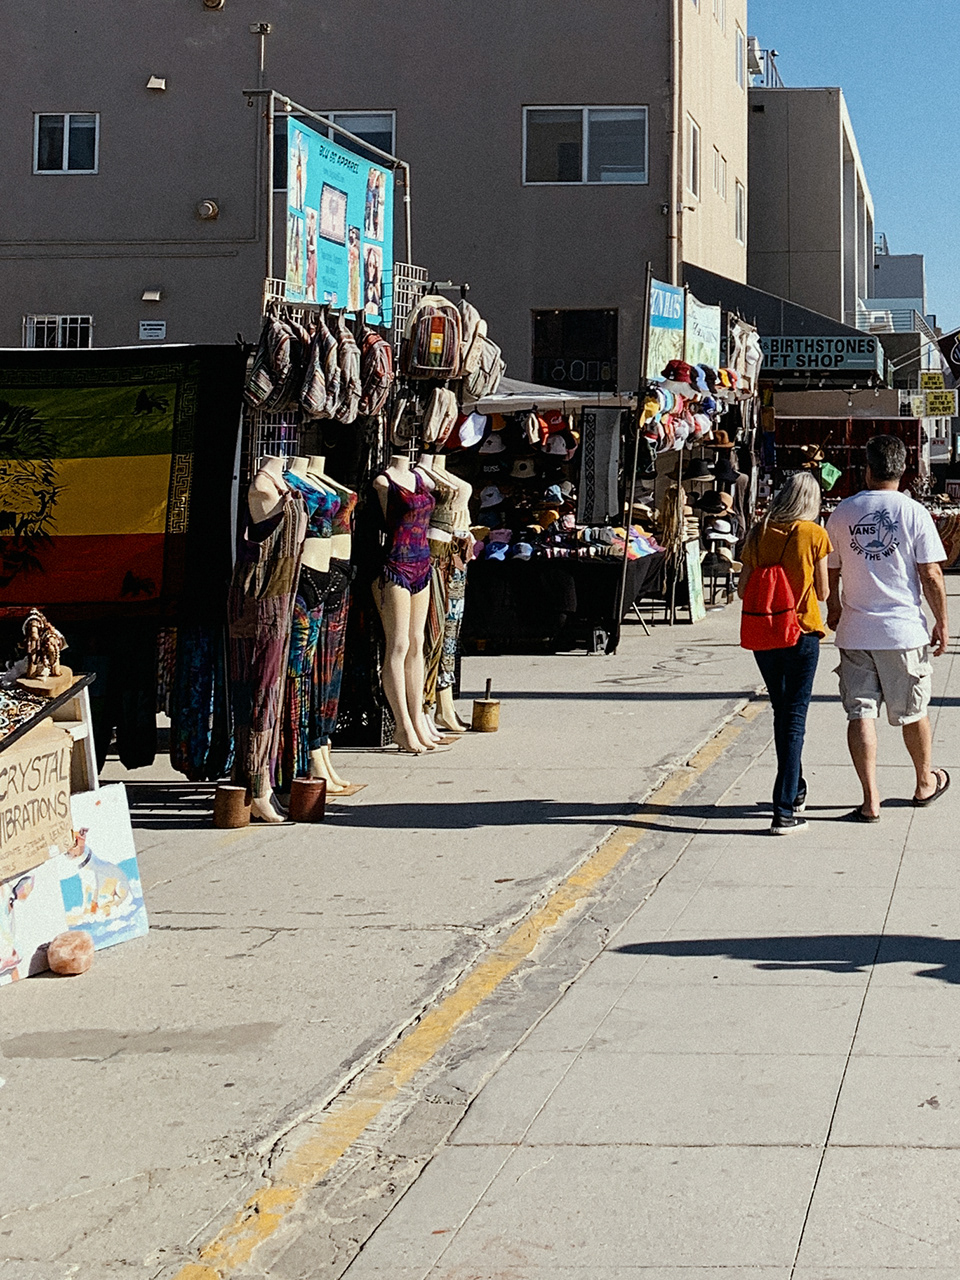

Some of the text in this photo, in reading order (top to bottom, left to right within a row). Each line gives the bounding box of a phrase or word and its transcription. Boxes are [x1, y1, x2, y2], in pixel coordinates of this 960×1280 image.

[770, 339, 875, 354] BIRTHSTONES
[761, 354, 845, 368] IFT SHOP
[848, 523, 877, 536] VANS
[864, 551, 882, 561] THE
[0, 790, 68, 850] IBRATIONS
